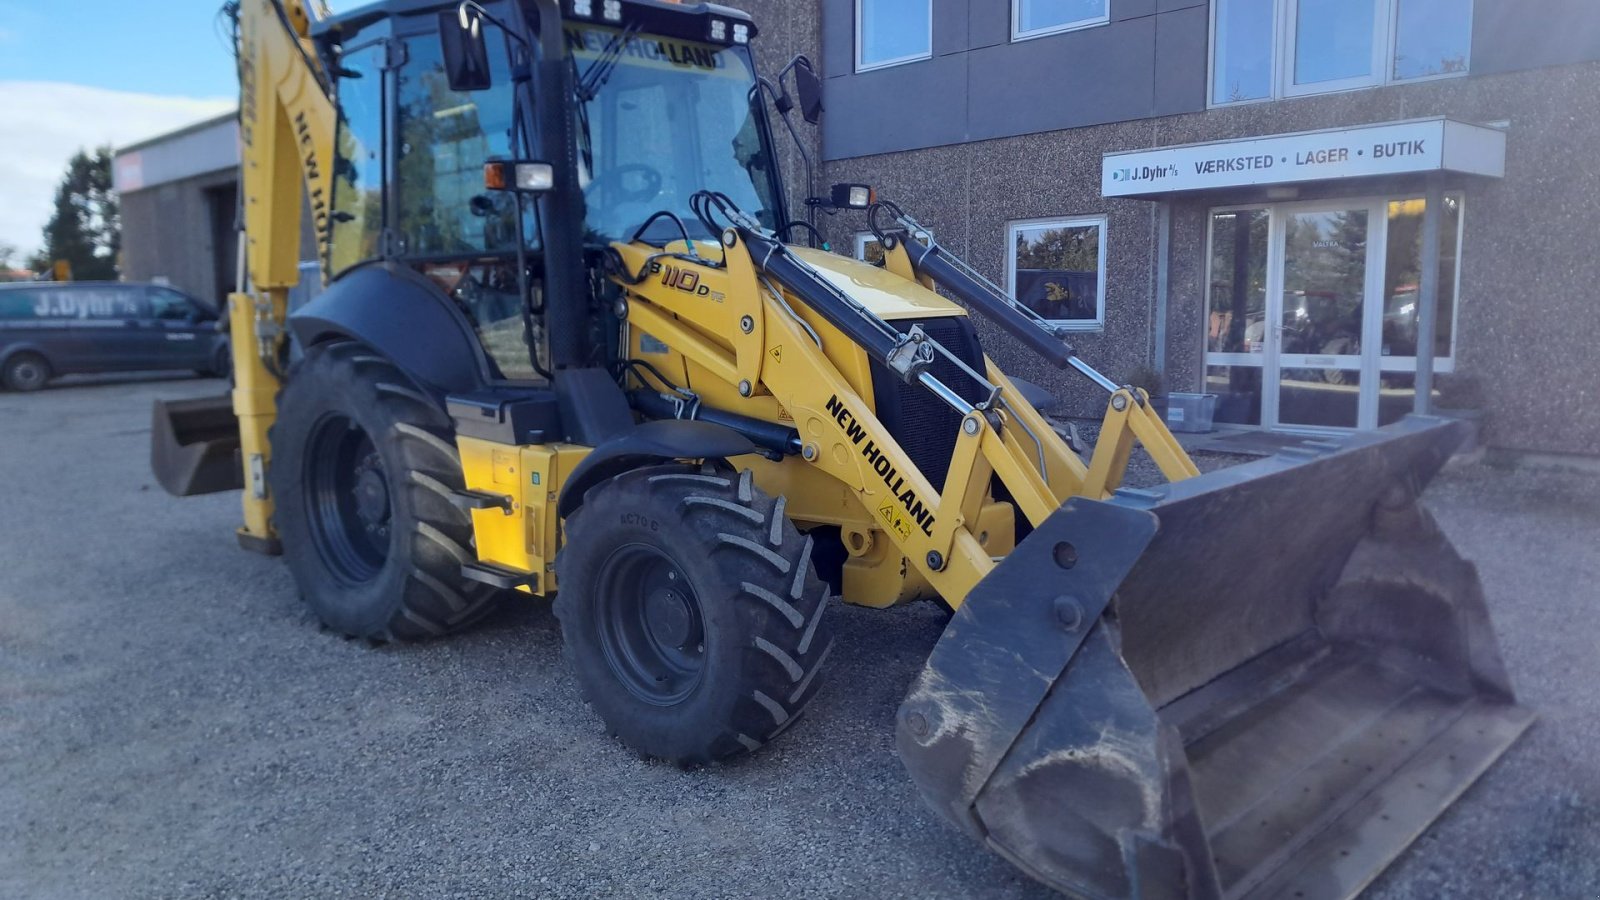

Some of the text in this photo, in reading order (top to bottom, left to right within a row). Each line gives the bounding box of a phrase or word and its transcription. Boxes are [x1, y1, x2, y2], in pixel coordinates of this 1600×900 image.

[625, 36, 726, 70] HOLLAND
[295, 110, 319, 181] NEW
[1132, 164, 1168, 181] J.Dyhr
[1195, 154, 1273, 174] VÆRKSTED
[1296, 147, 1348, 166] LAGER
[1373, 139, 1425, 159] BUTIK
[826, 394, 867, 445] NEW
